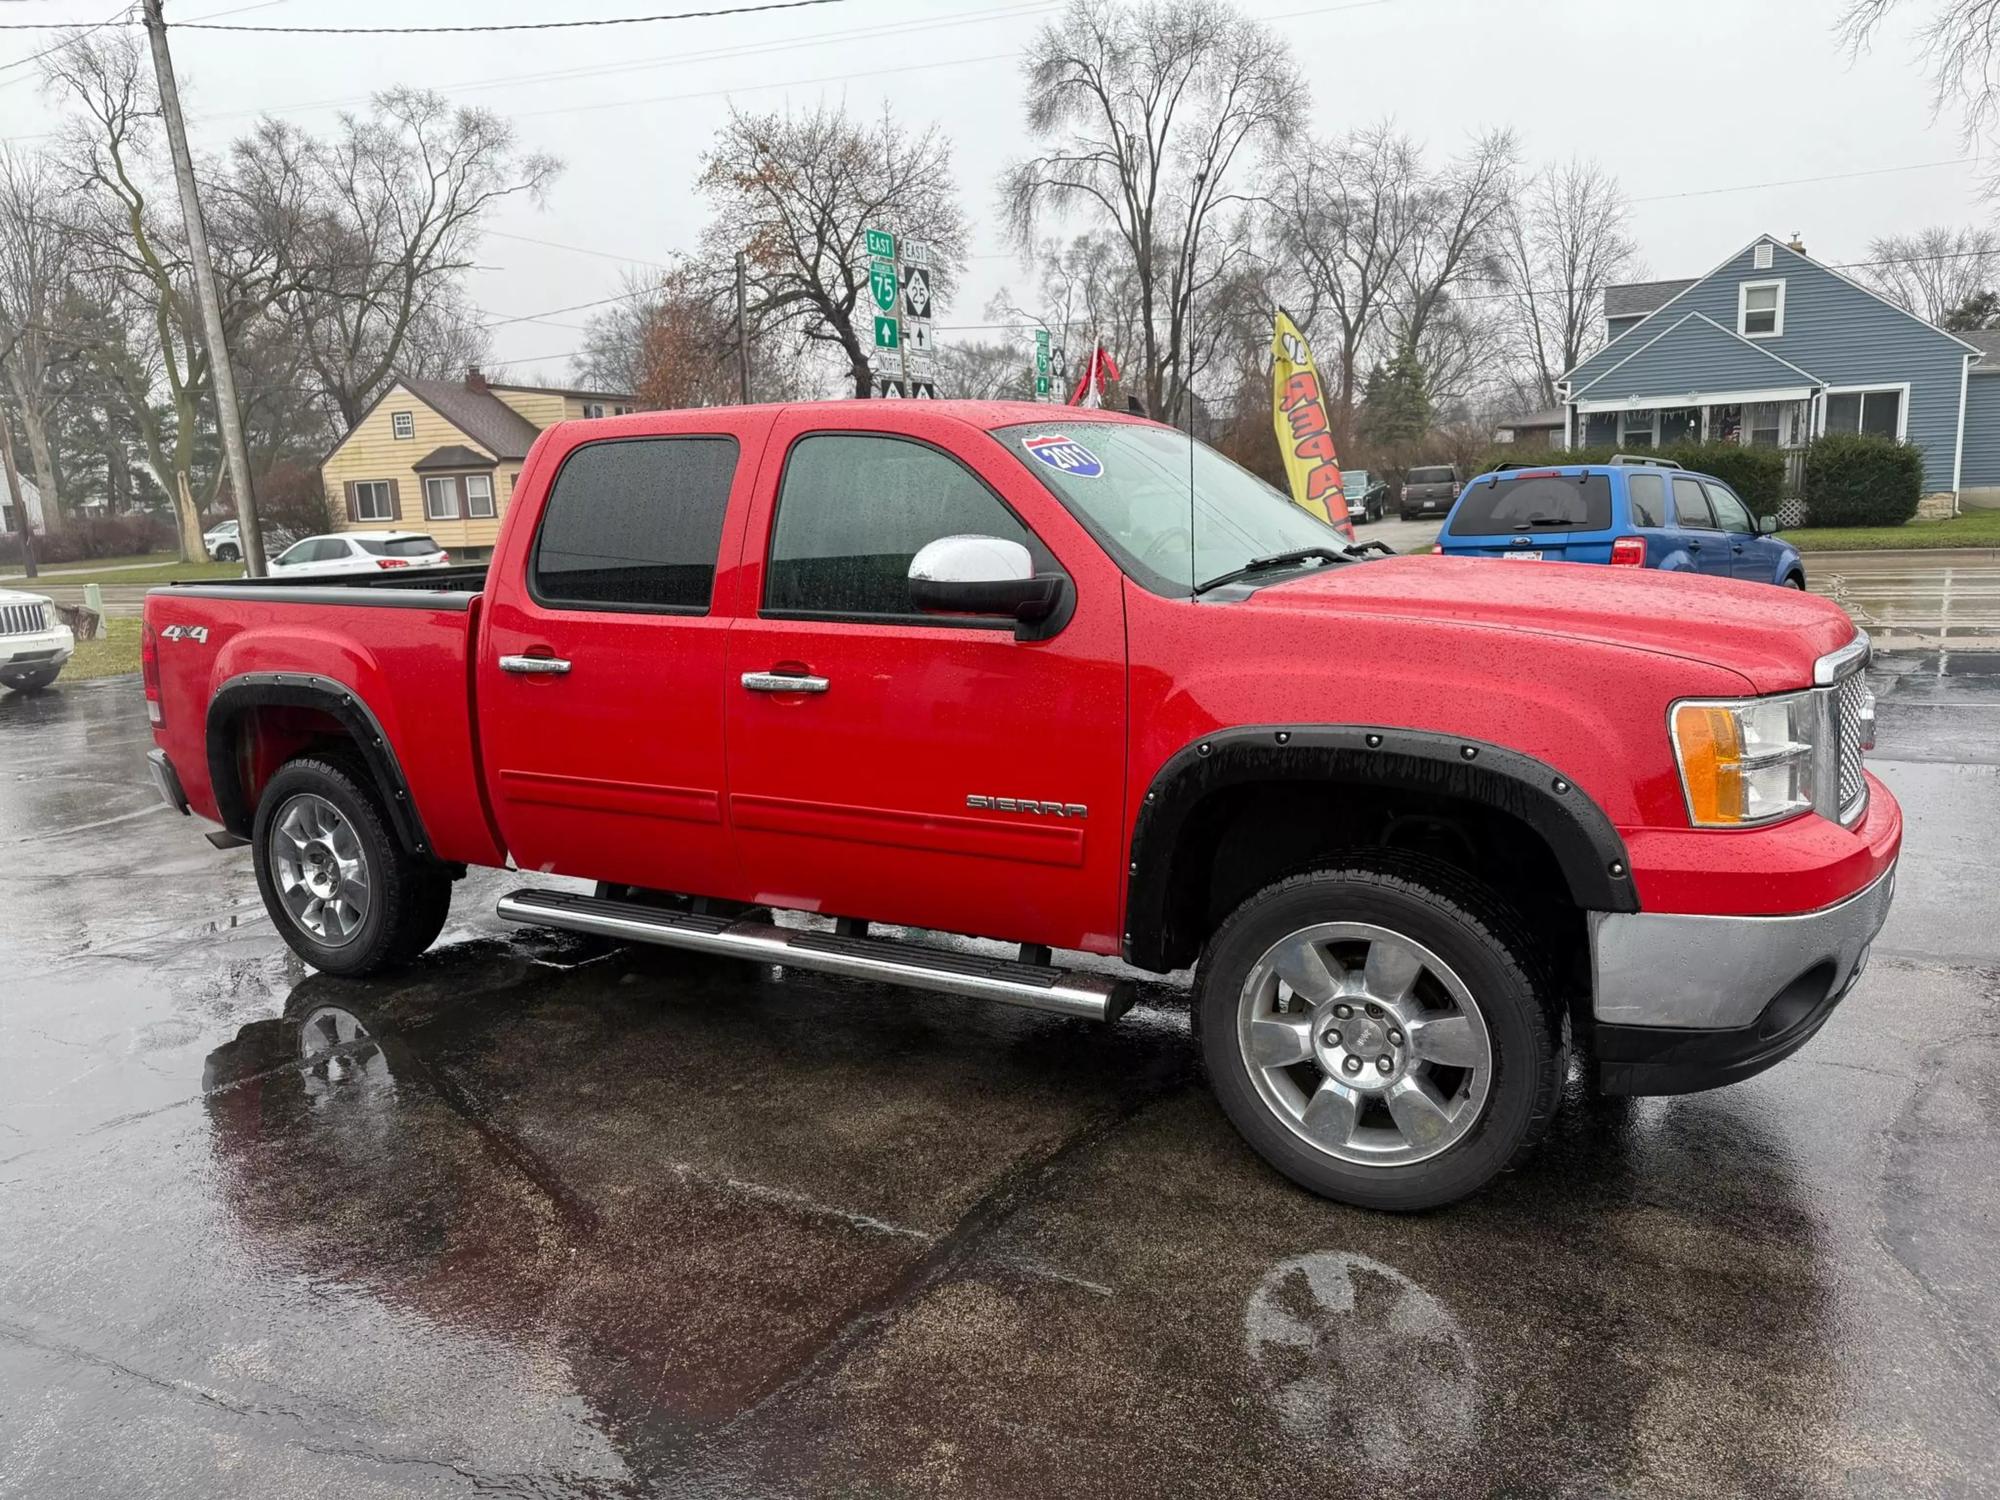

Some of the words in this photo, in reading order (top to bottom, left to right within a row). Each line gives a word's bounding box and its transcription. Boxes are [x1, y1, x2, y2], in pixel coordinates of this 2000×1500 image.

[869, 233, 890, 254] EAST
[905, 241, 924, 259] EAST
[874, 276, 893, 301] 75
[914, 277, 920, 285] M
[912, 286, 926, 305] 25
[880, 354, 901, 372] NORTH
[911, 358, 931, 375] SOUTH
[1038, 354, 1047, 369] 75
[1041, 445, 1098, 469] 2011
[966, 794, 1088, 818] SIERRA
